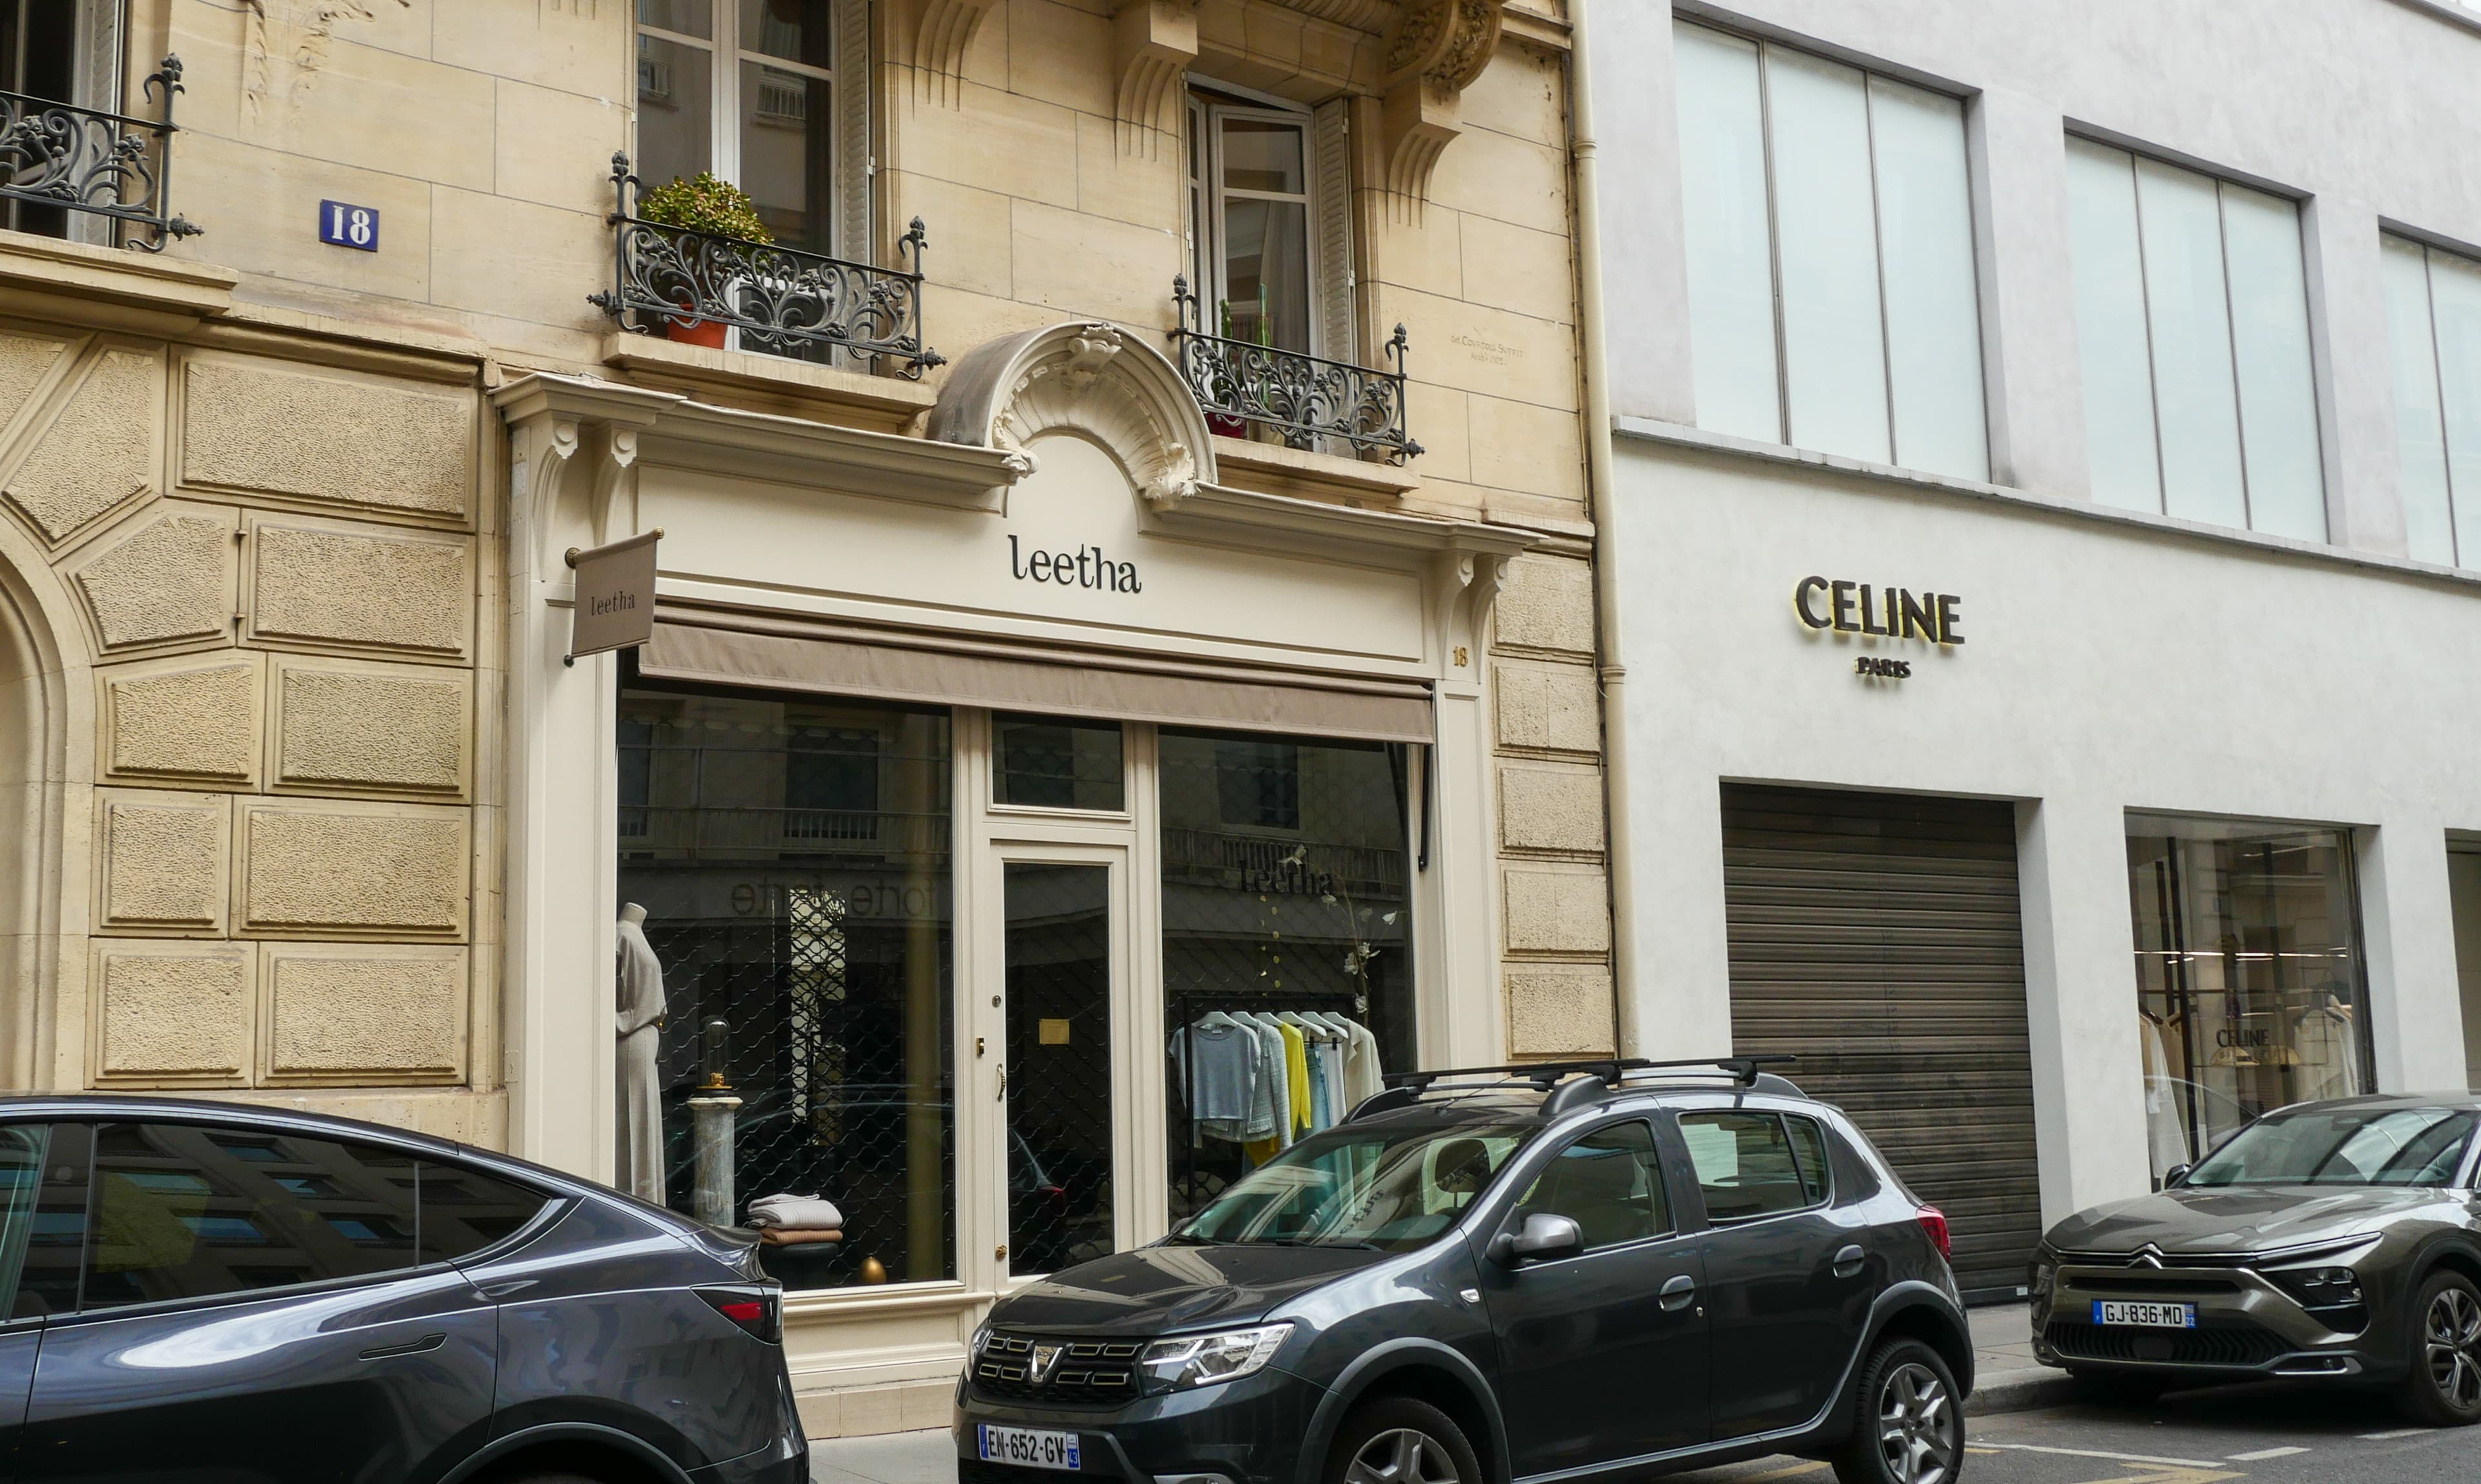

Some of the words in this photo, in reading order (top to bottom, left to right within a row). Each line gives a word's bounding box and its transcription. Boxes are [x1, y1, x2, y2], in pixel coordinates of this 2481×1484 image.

[331, 205, 371, 245] 18
[1008, 534, 1142, 594] leetha
[591, 590, 635, 616] leetha
[1795, 576, 1965, 644] CELINE
[1453, 646, 1468, 667] 18
[1856, 656, 1911, 678] PARIS
[1238, 860, 1334, 895] leetha
[2217, 1029, 2269, 1047] CELINE
[2106, 1304, 2182, 1324] GJ-836-MD
[2186, 1317, 2195, 1326] 22
[988, 1430, 1065, 1464] EN-652-GV
[1069, 1452, 1078, 1465] 43
